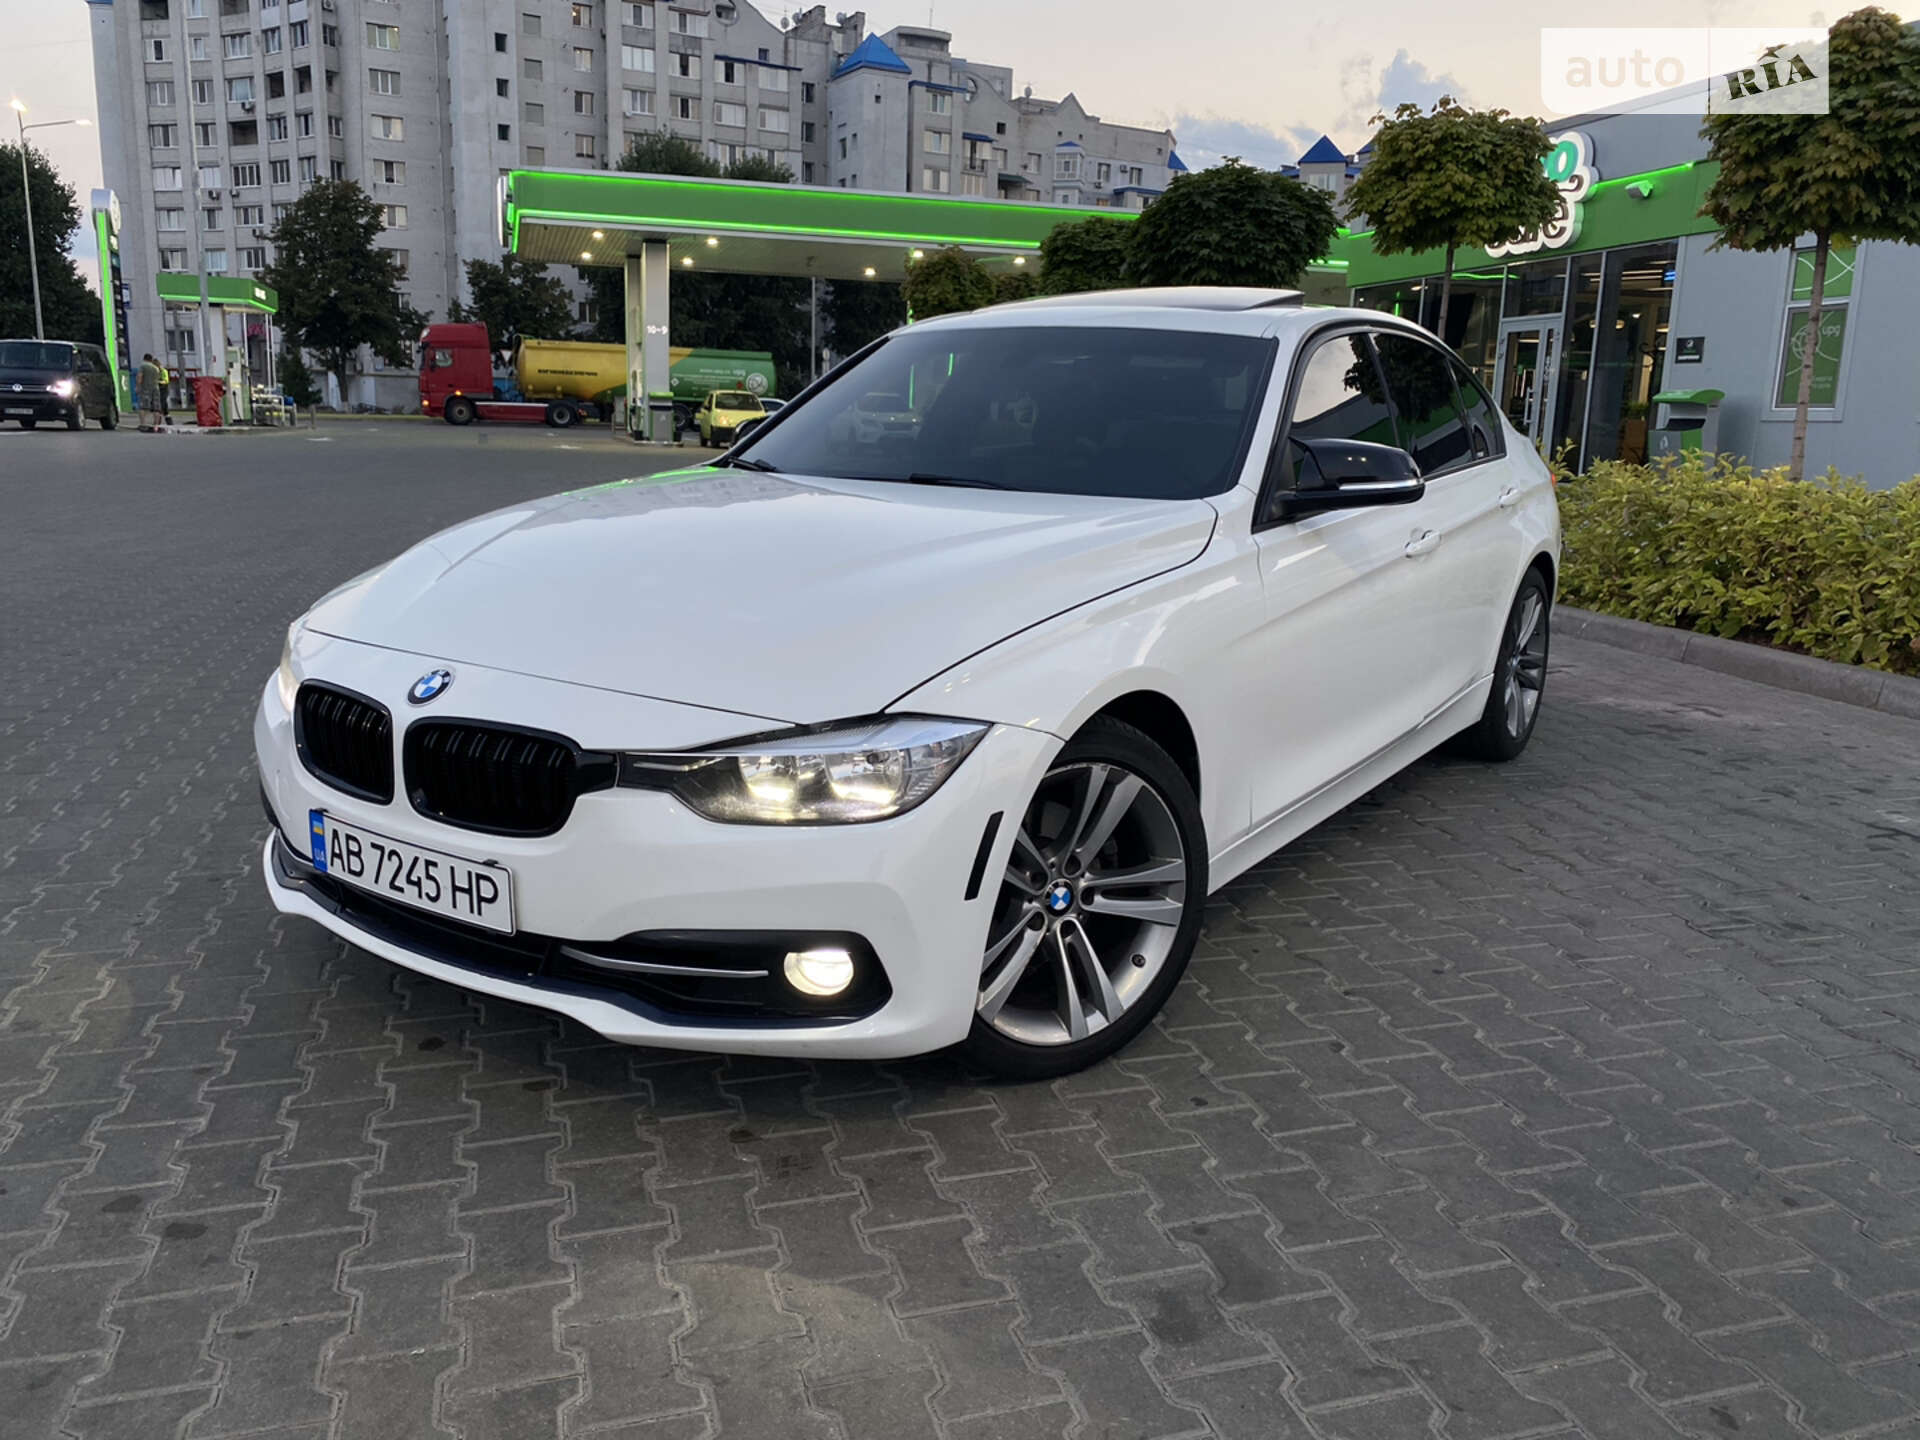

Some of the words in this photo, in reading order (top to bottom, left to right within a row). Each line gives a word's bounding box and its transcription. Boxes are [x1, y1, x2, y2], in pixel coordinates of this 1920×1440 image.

[330, 828, 365, 878] AB
[370, 842, 441, 903] 7245
[450, 866, 499, 916] HP
